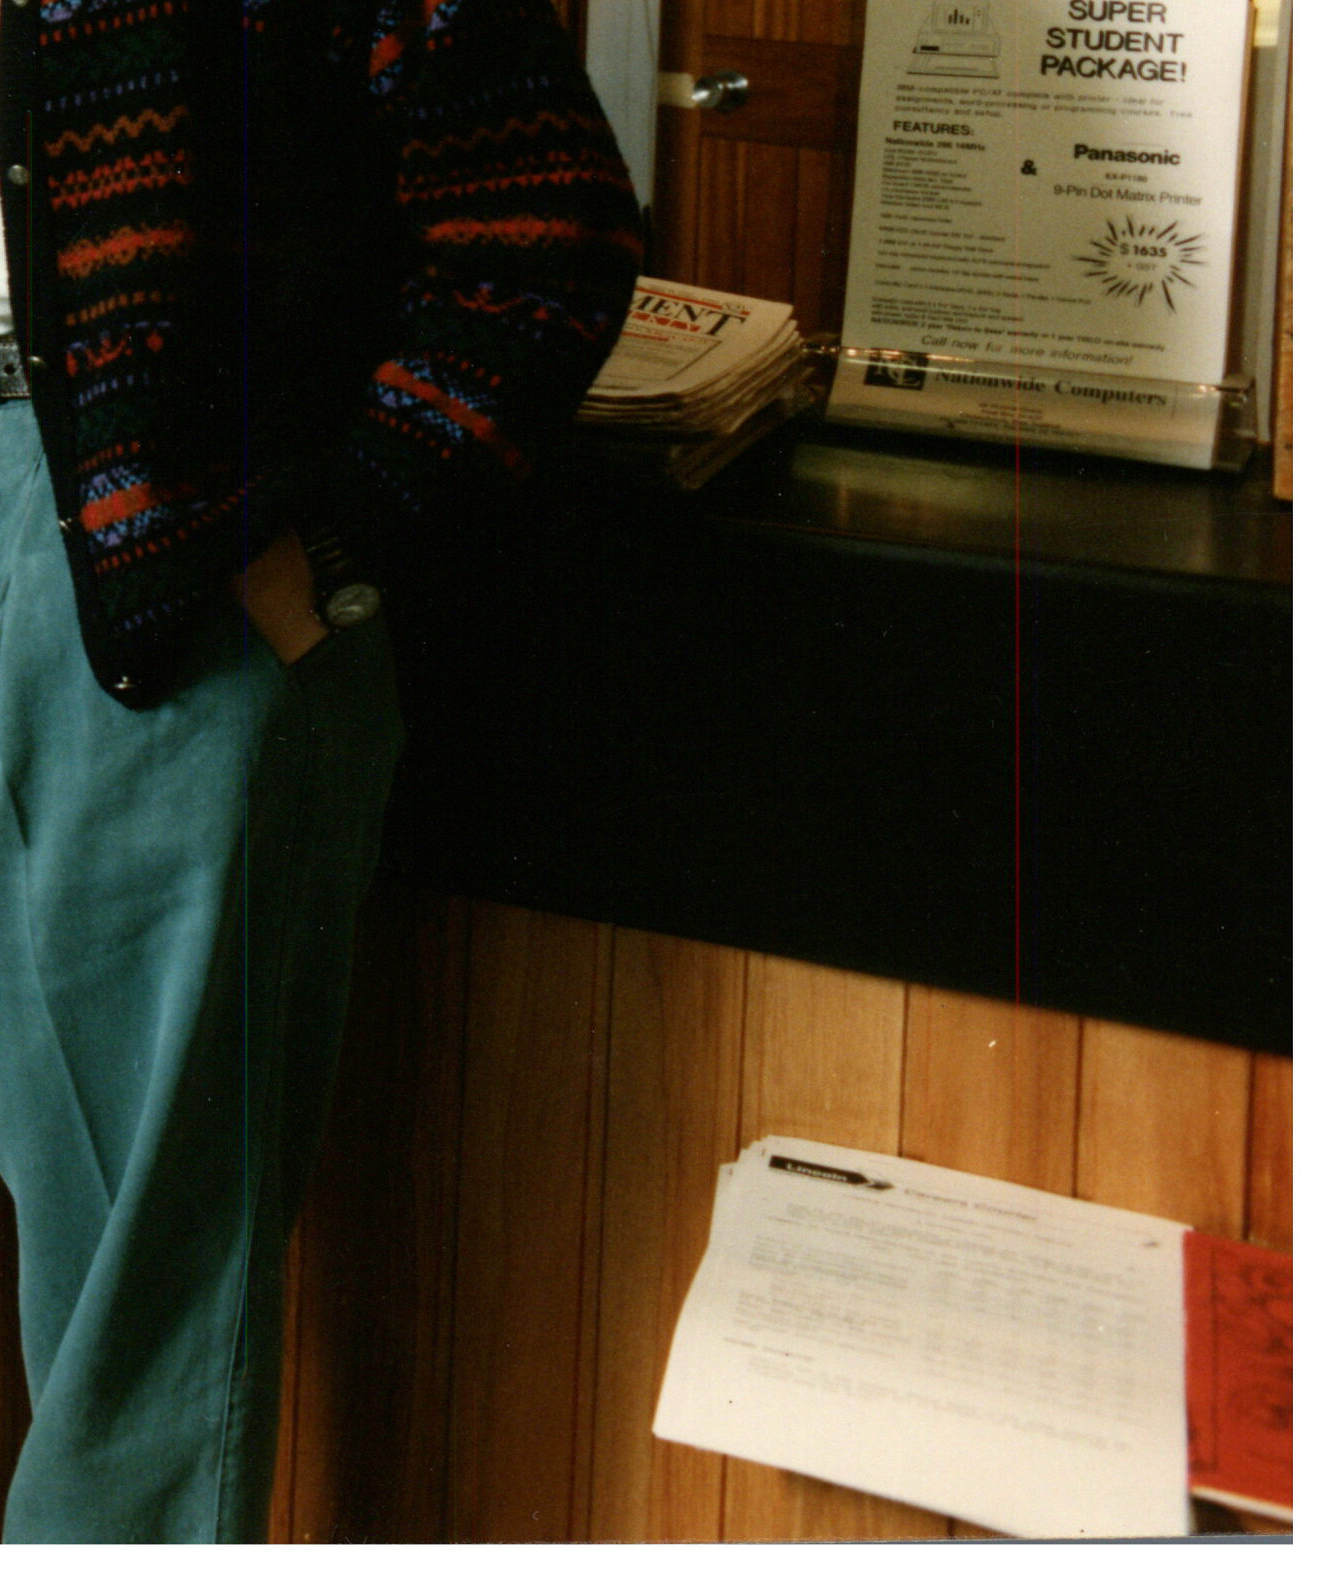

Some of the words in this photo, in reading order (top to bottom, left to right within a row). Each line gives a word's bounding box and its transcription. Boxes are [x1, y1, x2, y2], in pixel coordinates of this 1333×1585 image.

[1045, 27, 1184, 54] STUDENT
[1039, 54, 1187, 83] PACKAGE!
[892, 120, 975, 136] FEATURES:
[1074, 143, 1181, 165] Panasonic
[1020, 159, 1037, 176] &
[1053, 184, 1087, 197] 9-Pin
[1090, 186, 1113, 199] Dot
[1116, 189, 1155, 203] Matrix
[1159, 191, 1203, 206] Printer
[1134, 244, 1168, 258] 1635
[920, 334, 948, 347] Call
[951, 339, 980, 351] now
[985, 341, 1002, 353] for
[1009, 346, 1045, 358] more
[1053, 379, 1168, 406] Computers
[785, 1161, 849, 1183] Lincoln
